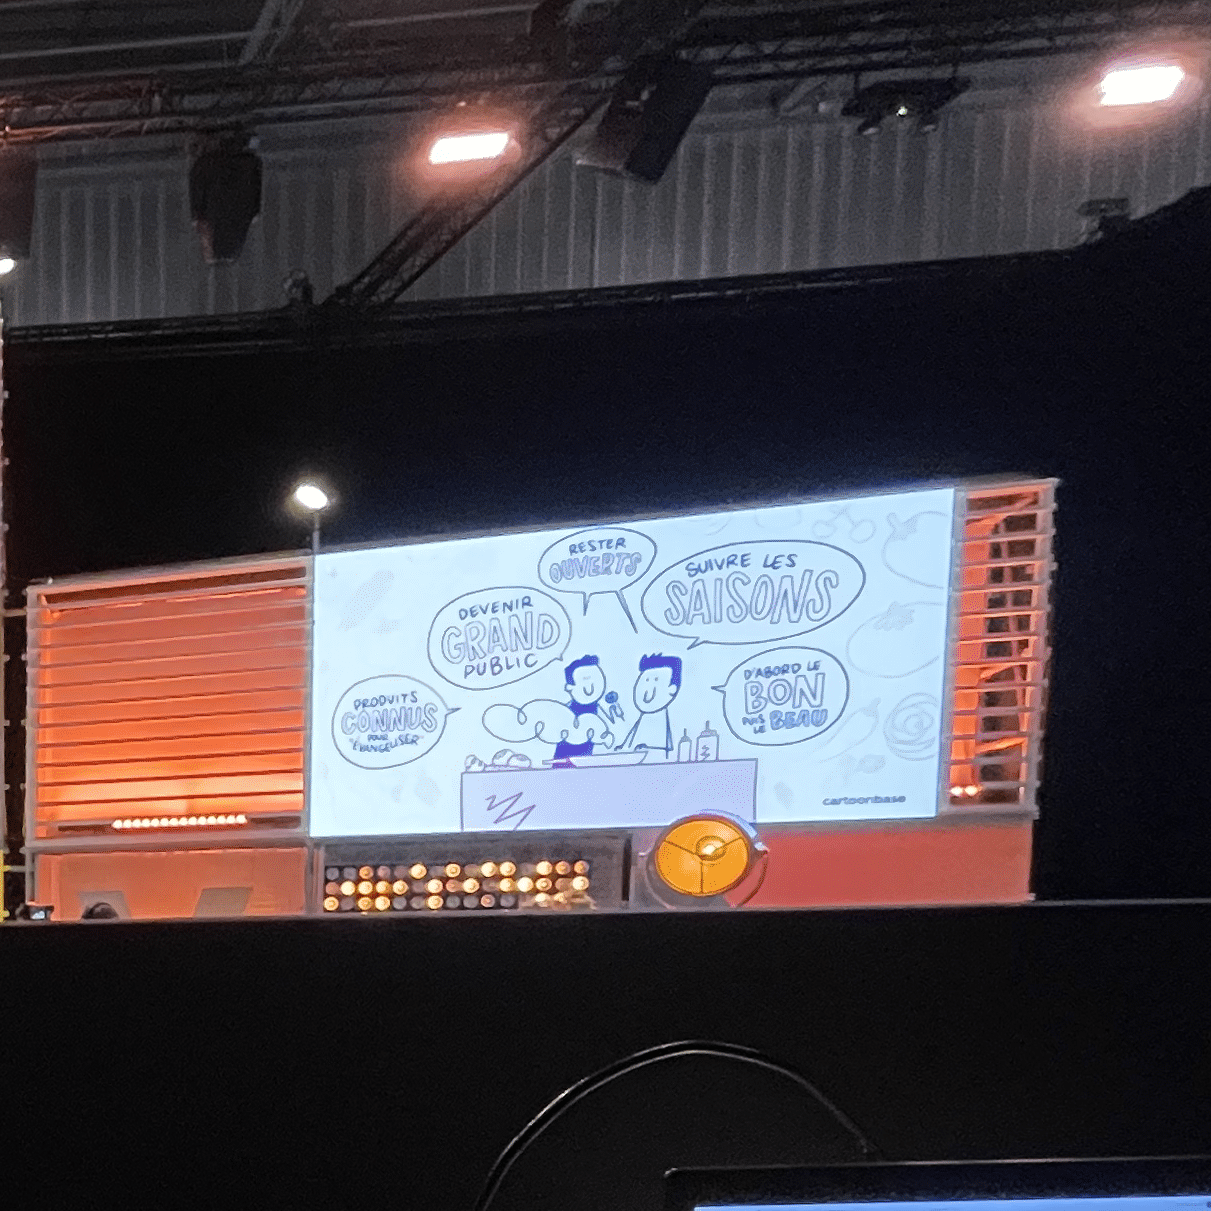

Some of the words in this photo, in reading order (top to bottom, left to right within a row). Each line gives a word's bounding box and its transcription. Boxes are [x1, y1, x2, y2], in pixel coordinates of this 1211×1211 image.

[569, 537, 626, 556] RESTER
[550, 552, 642, 584] OUVERTS
[685, 552, 752, 577] SUIVRE
[763, 553, 798, 570] LES
[459, 596, 533, 621] DEVENIR
[664, 569, 840, 626] SAISONS
[441, 611, 560, 664] GRAND
[463, 653, 538, 679] PUBLIC
[744, 663, 801, 680] D'ABORD
[806, 660, 822, 672] LE
[353, 690, 418, 711] PRODUITS
[744, 672, 826, 715] BON
[340, 702, 439, 736] CONNUS
[769, 708, 829, 731] BEAU
